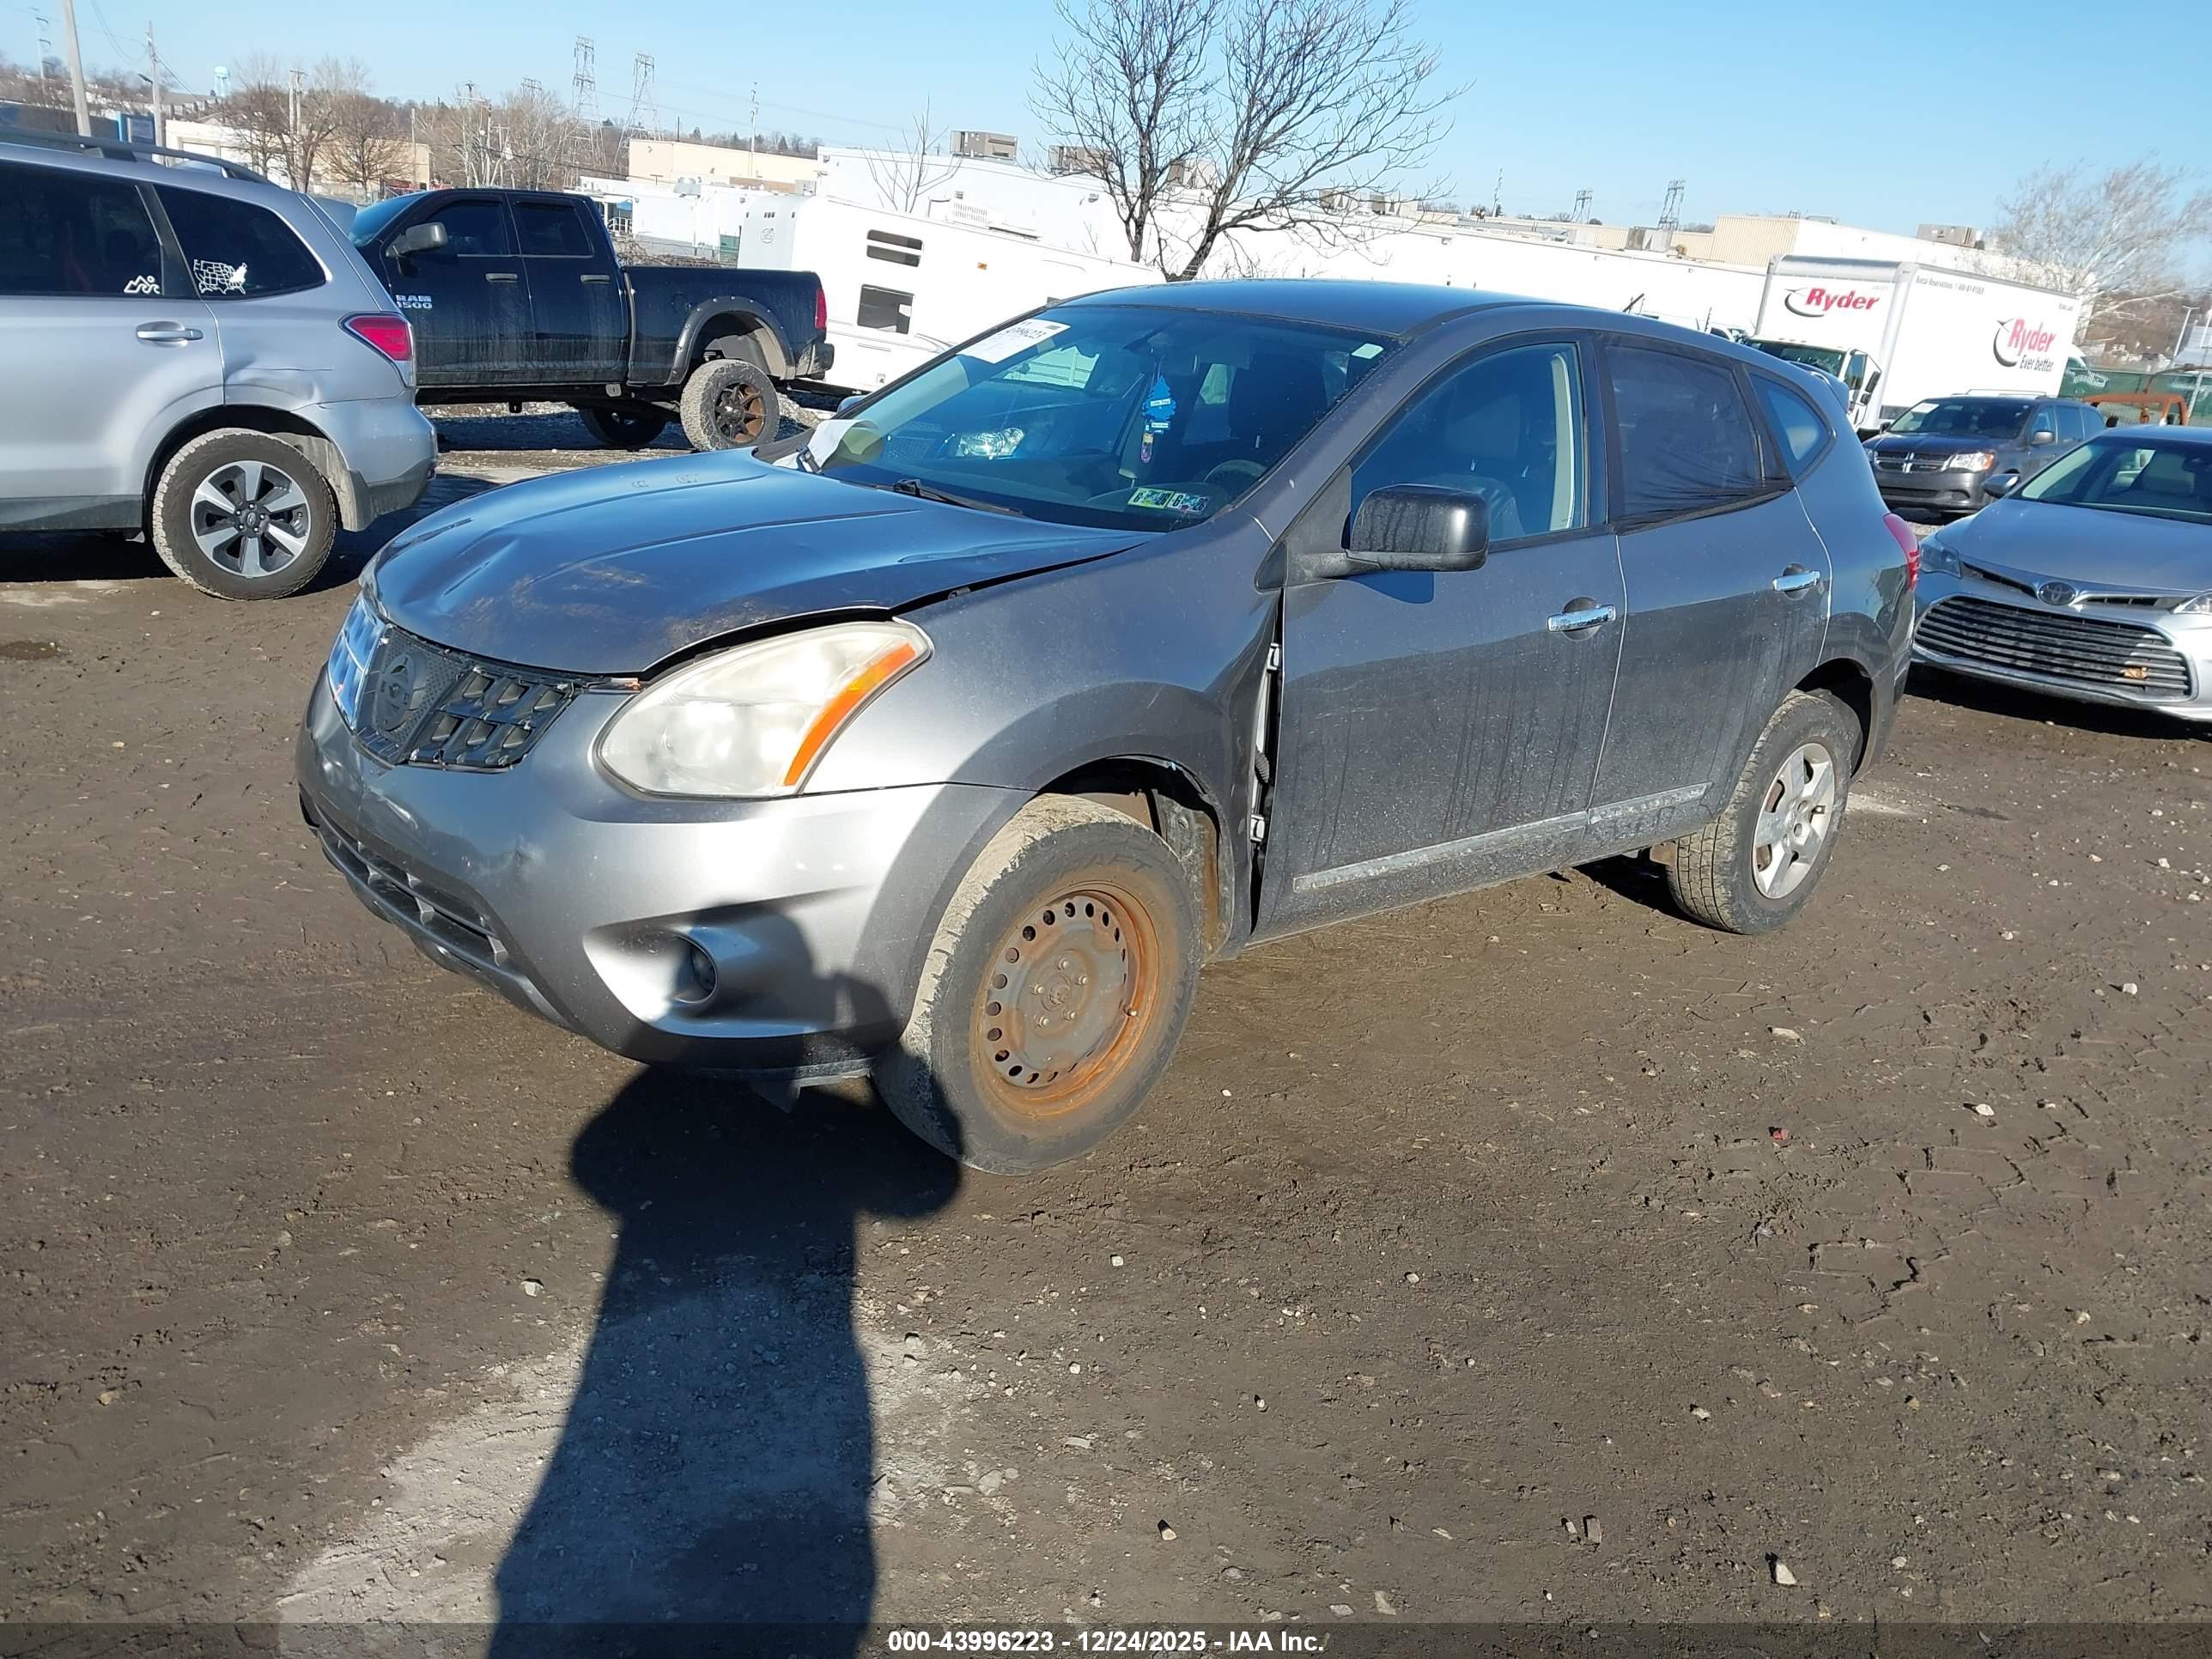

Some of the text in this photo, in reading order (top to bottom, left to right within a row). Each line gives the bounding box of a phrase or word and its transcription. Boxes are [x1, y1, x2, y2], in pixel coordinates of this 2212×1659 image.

[1805, 288, 1881, 312] Ryder
[2008, 319, 2055, 356] Ryder
[2020, 355, 2034, 370] Ever
[1172, 495, 1183, 507] 6
